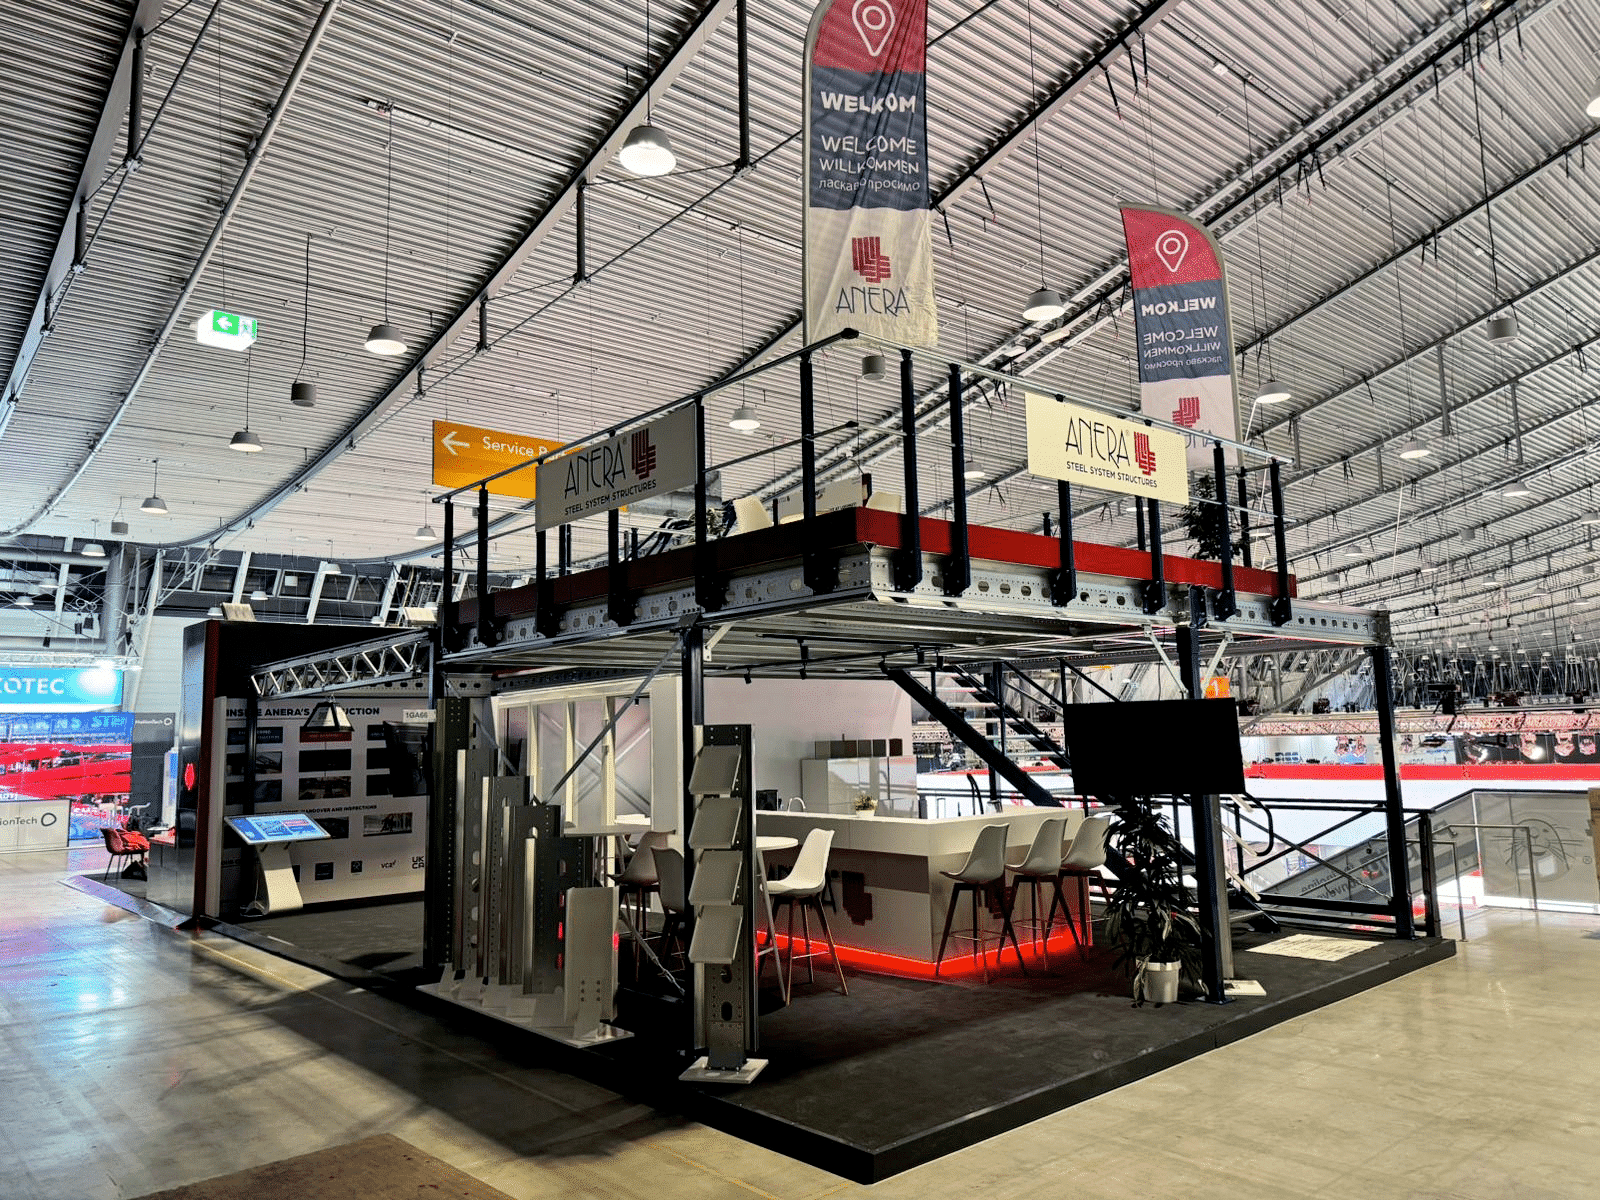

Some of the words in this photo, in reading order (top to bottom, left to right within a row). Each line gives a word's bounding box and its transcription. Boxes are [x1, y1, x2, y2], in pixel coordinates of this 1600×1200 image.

[821, 91, 917, 115] WELKOM
[821, 135, 917, 155] WELCOME
[819, 156, 919, 175] WILLKOMMEN
[868, 179, 920, 192] просимо
[836, 286, 910, 317] ANERA
[482, 436, 534, 457] Service
[1065, 415, 1131, 469] ANERA
[564, 440, 627, 500] ANERA
[1066, 460, 1088, 473] STEEL
[1089, 465, 1116, 479] SYSTEM
[1117, 472, 1158, 488] STRUCTURES
[564, 503, 584, 516] STEEL
[585, 493, 611, 509] SYSTEM
[612, 479, 657, 501] STRUCTURES
[0, 677, 65, 695] OTEC
[264, 707, 310, 717] ANERA'S
